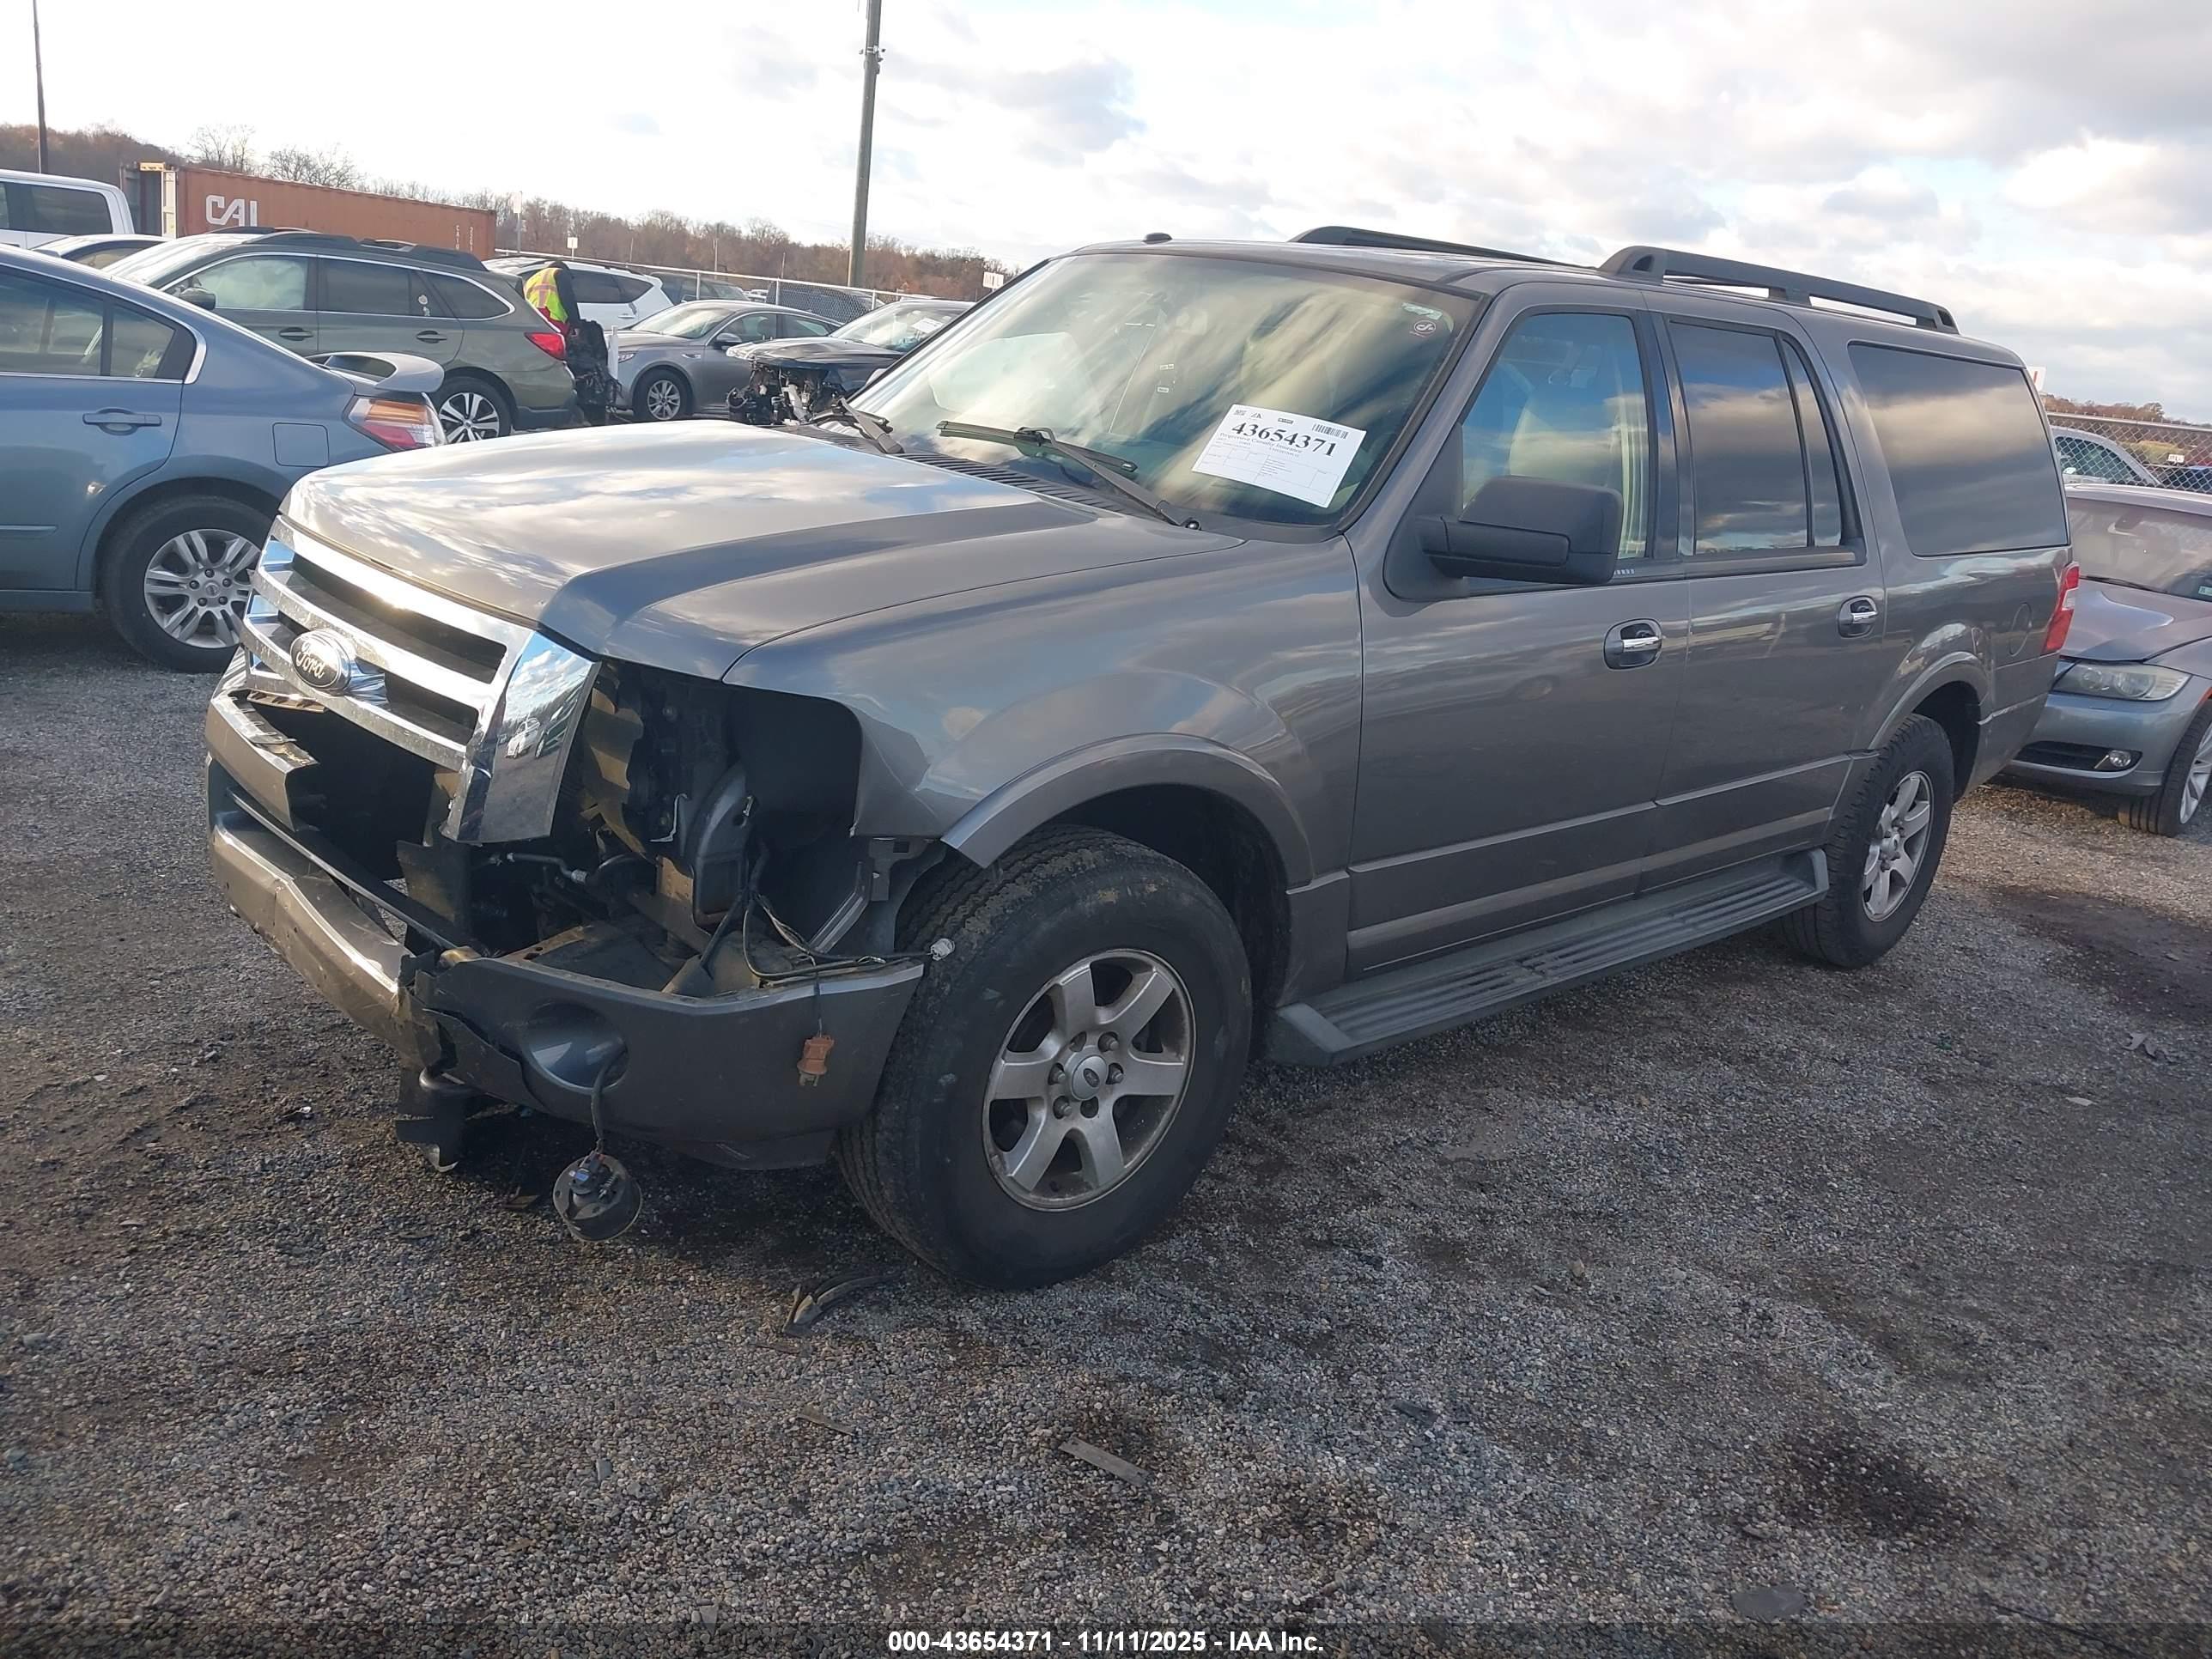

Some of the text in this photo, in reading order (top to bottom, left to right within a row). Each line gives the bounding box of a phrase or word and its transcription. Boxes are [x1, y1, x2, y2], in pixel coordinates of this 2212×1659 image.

[206, 194, 258, 228] CAI
[1231, 422, 1337, 457] 43654371
[295, 640, 325, 679] Ford
